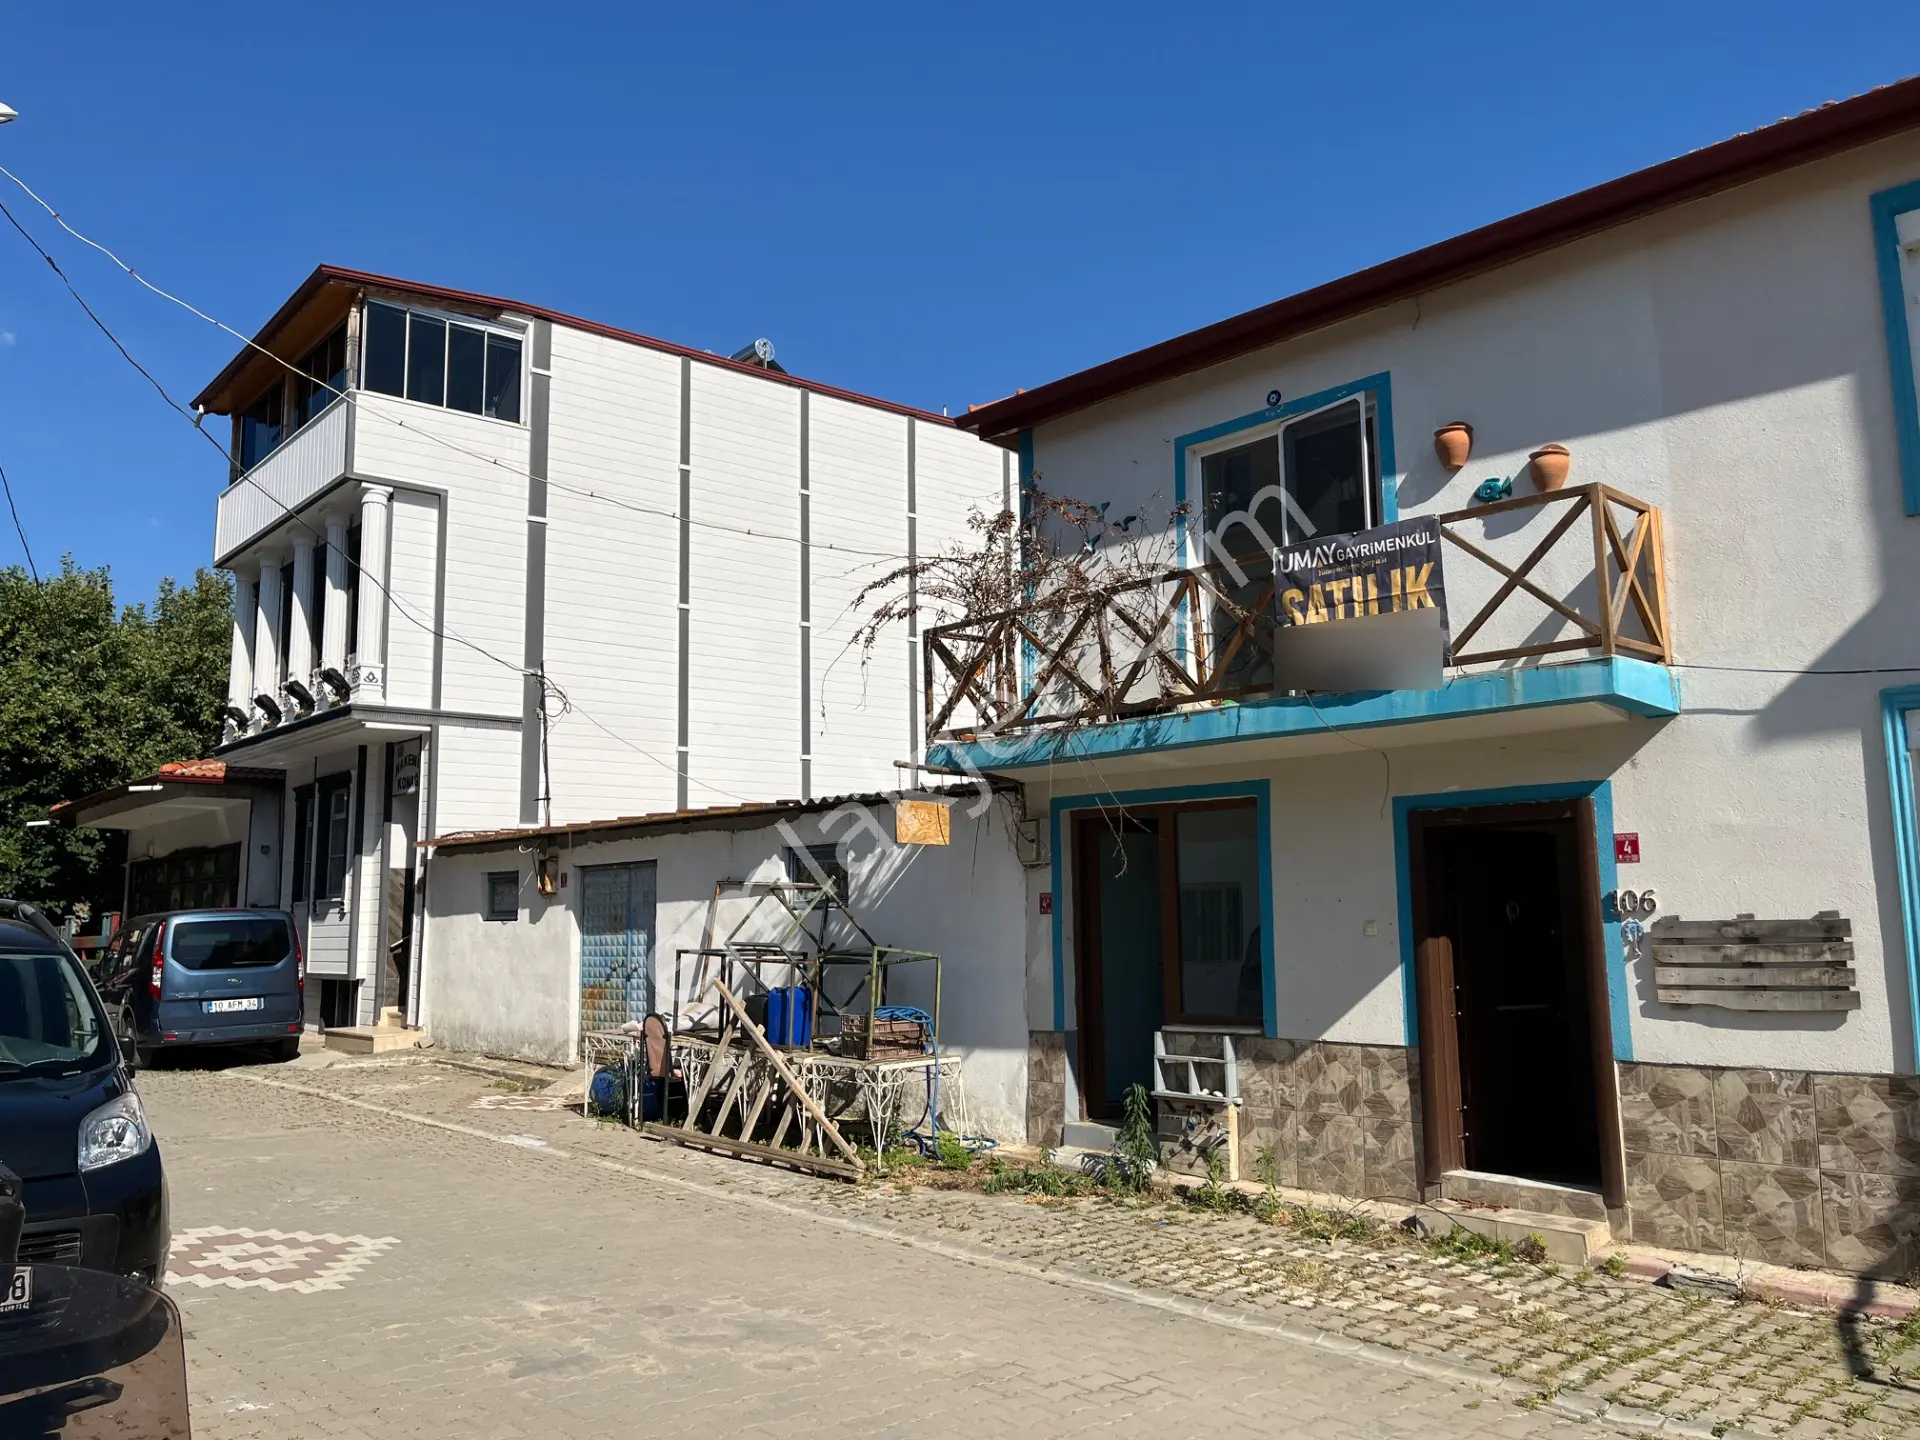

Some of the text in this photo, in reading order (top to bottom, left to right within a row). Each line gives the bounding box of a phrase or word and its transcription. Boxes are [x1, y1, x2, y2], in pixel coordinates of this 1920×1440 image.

[1623, 840, 1632, 854] 4
[1610, 889, 1657, 913] 106
[214, 1002, 224, 1010] 10
[246, 999, 257, 1008] 34
